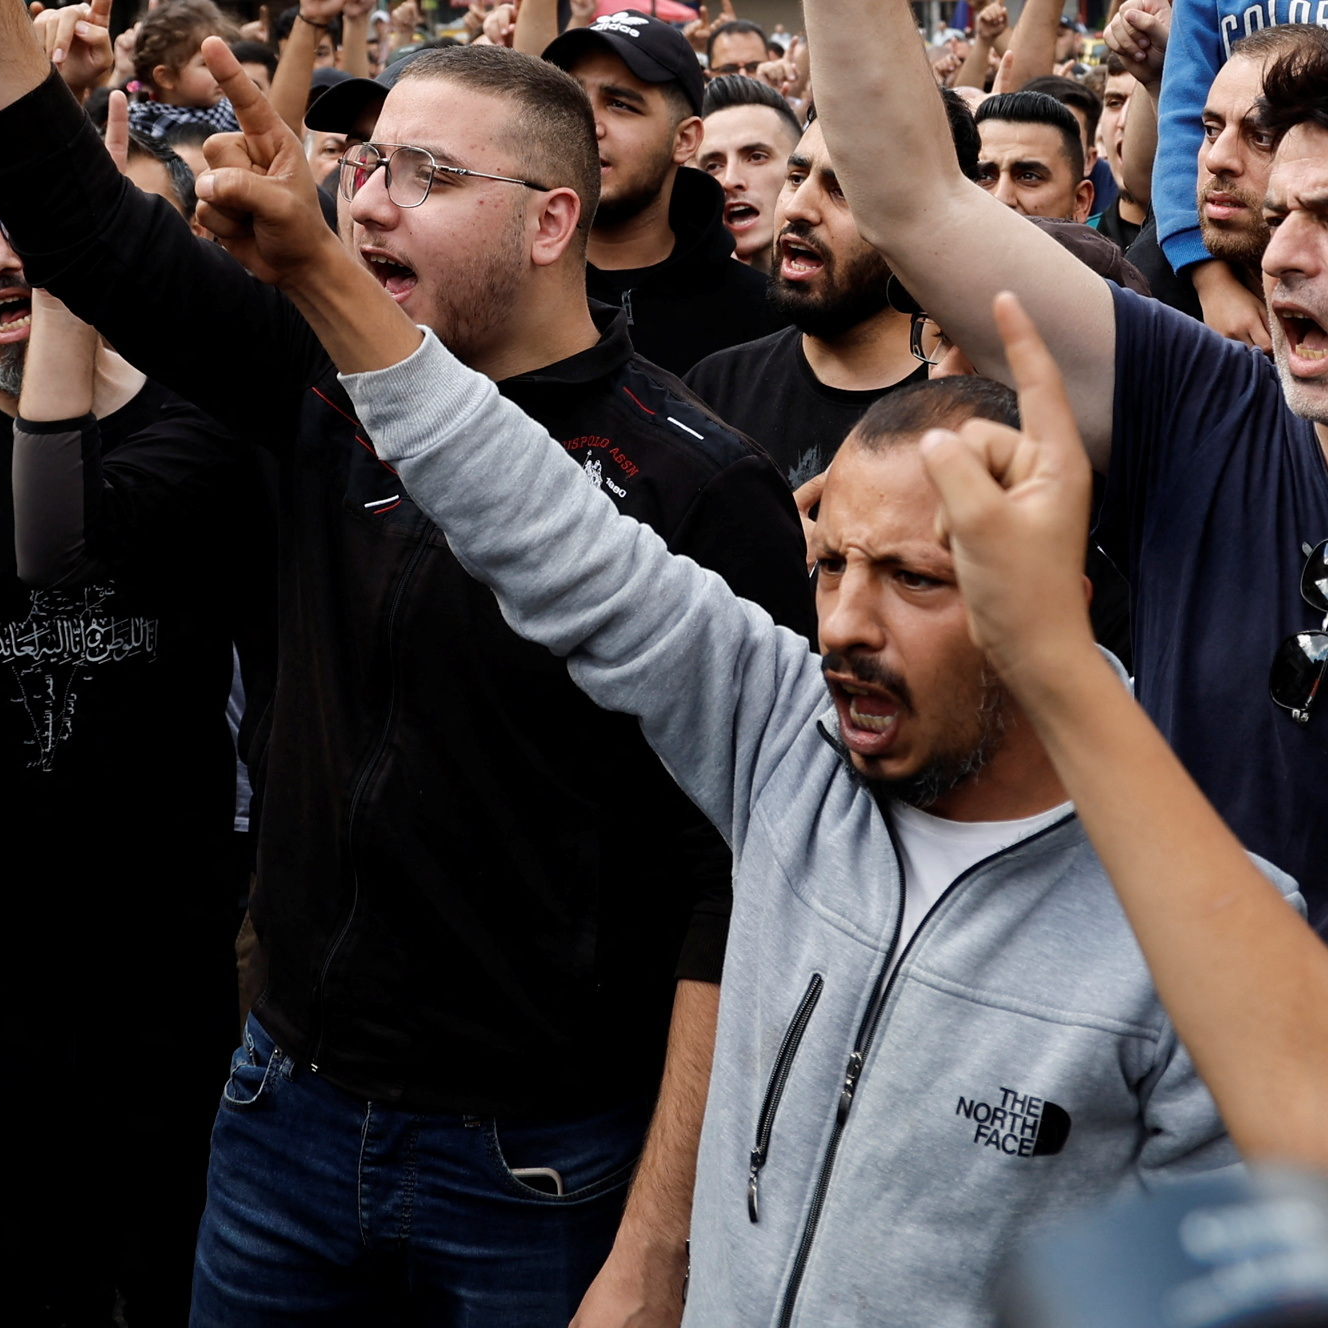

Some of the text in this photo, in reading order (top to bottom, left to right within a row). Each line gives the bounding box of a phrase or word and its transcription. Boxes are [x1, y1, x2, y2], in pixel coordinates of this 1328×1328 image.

[590, 22, 641, 38] adidas
[955, 1095, 1039, 1139] NORTH
[999, 1086, 1043, 1119] THE
[973, 1123, 1035, 1158] FACE
